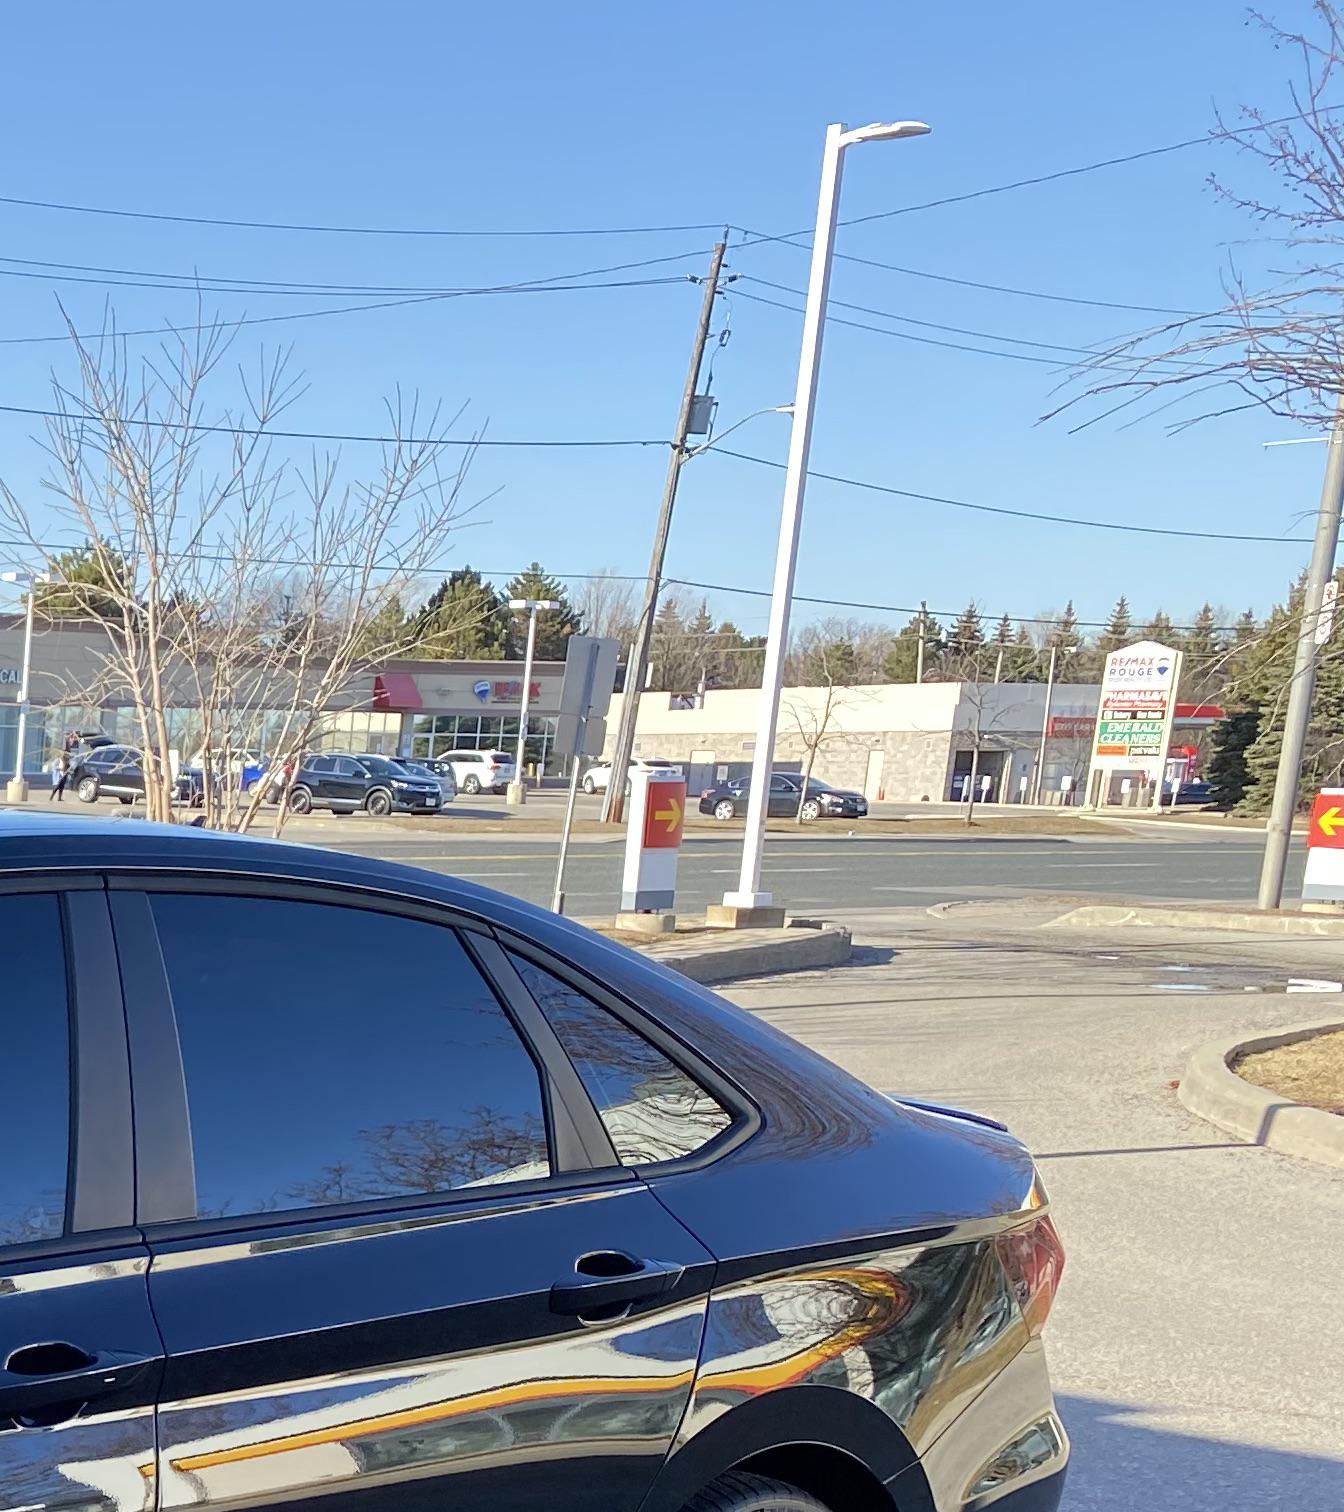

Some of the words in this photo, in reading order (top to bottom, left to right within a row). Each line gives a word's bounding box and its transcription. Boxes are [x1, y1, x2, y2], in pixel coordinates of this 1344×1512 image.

[1109, 667, 1154, 677] ROUGE
[1106, 722, 1164, 733] EMERALD
[1100, 733, 1162, 745] CLEANERS
